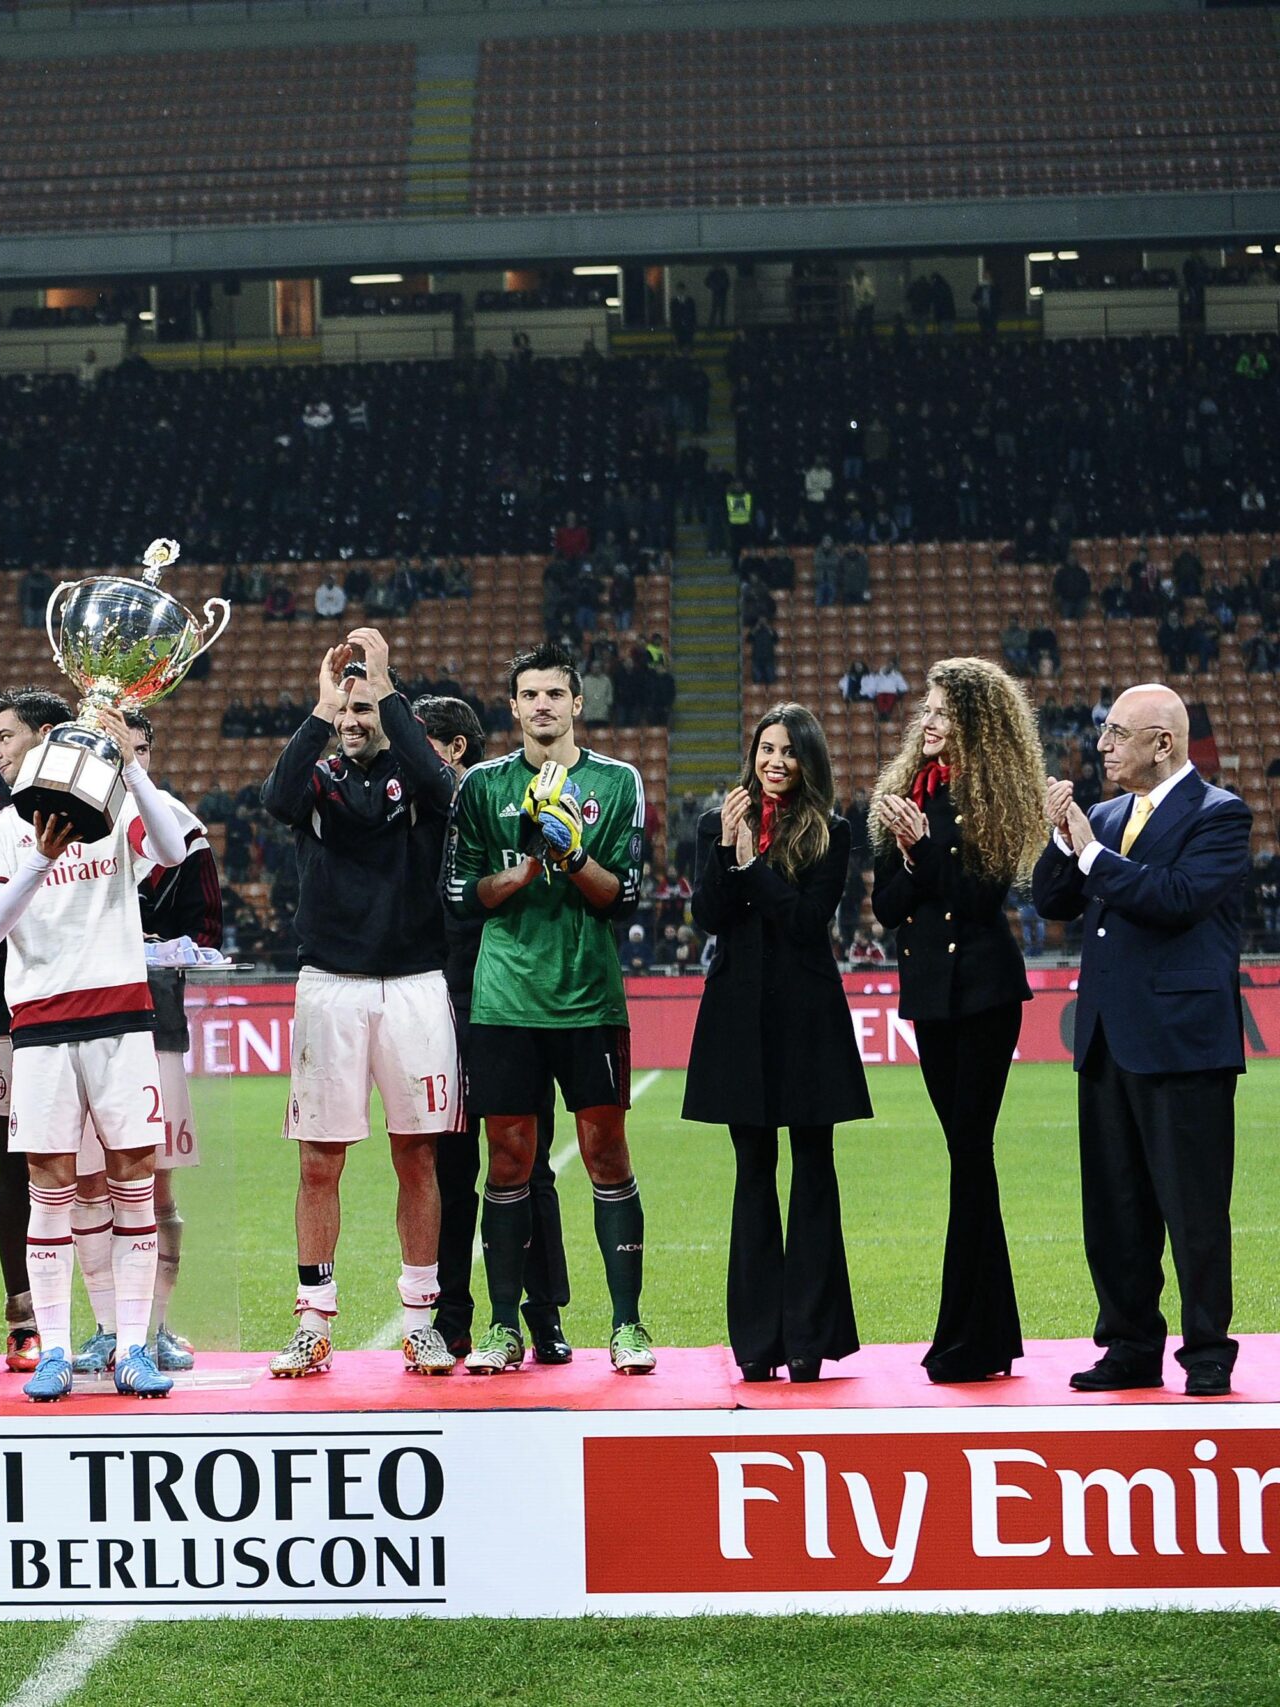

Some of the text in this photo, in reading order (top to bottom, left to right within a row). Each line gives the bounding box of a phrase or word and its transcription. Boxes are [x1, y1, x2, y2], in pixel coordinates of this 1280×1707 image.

[64, 842, 82, 859] ly
[45, 857, 118, 887] mirates
[142, 1085, 163, 1124] 2
[420, 1074, 448, 1113] 13
[164, 1118, 194, 1156] 16
[29, 1251, 57, 1260] ACM
[131, 1240, 157, 1251] ACM
[616, 1243, 644, 1252] ACM
[70, 1446, 445, 1524] TROFEO
[709, 1450, 929, 1584] Fly
[9, 1536, 446, 1590] BERLUSCONI
